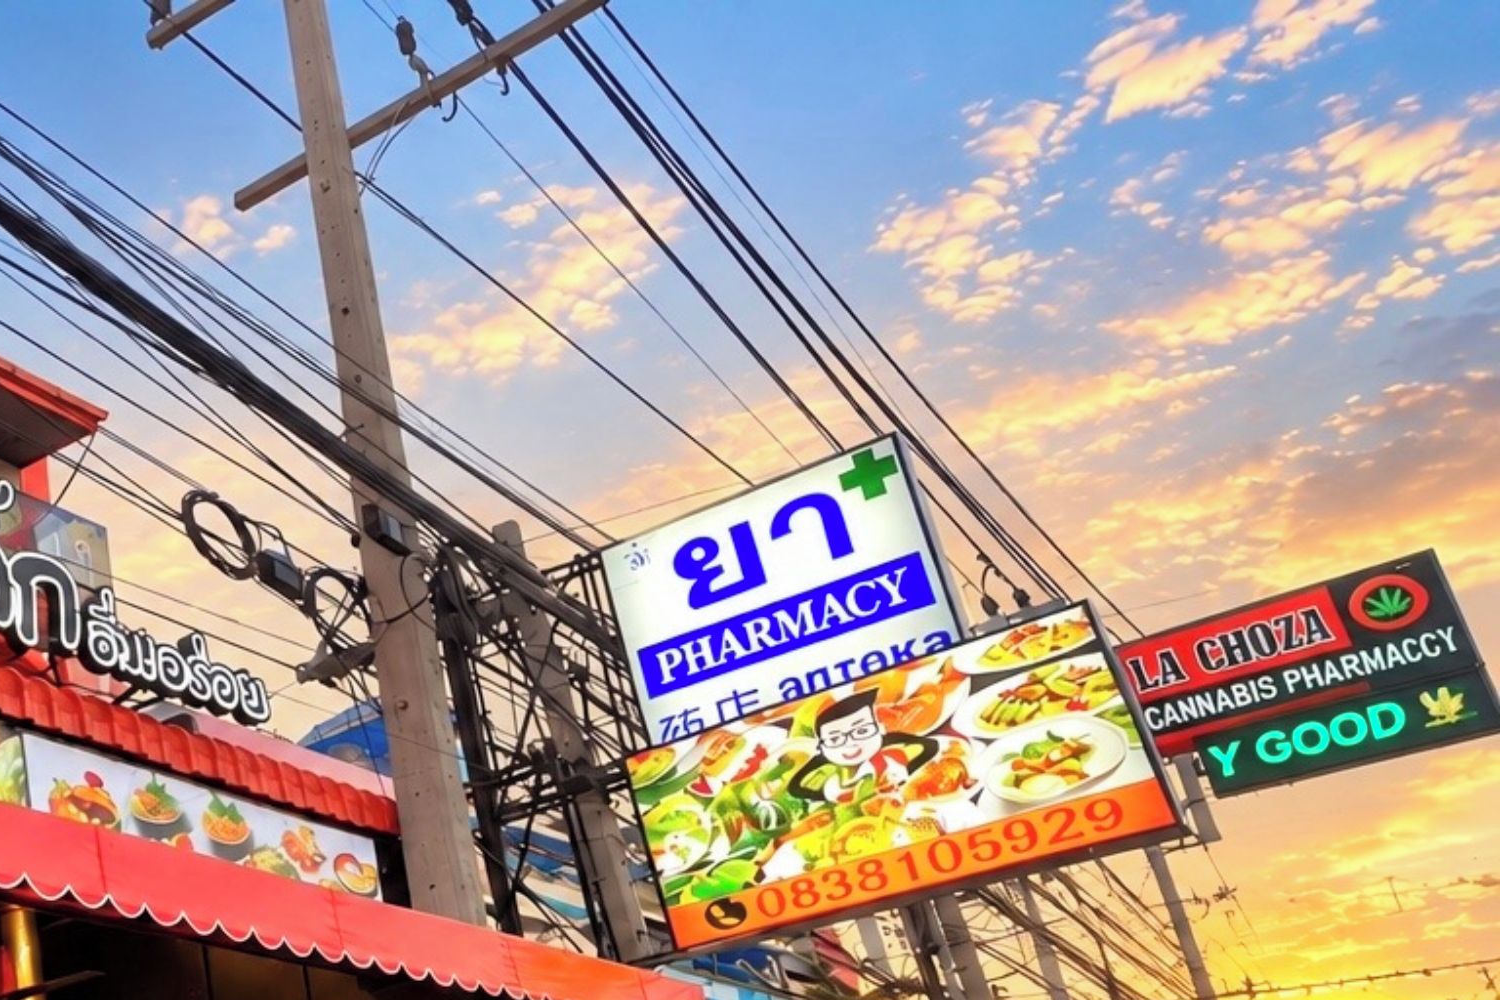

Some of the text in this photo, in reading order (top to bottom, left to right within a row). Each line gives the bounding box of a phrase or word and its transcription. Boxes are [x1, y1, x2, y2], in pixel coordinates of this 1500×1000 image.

[672, 491, 855, 611] ยา
[655, 565, 909, 686] PHARMACY
[1128, 606, 1337, 694] LA CHOZA
[1143, 626, 1459, 732] CANNABIS PHARMACCY
[1207, 701, 1407, 777] Y GOOD
[756, 797, 1124, 919] 0838105929
